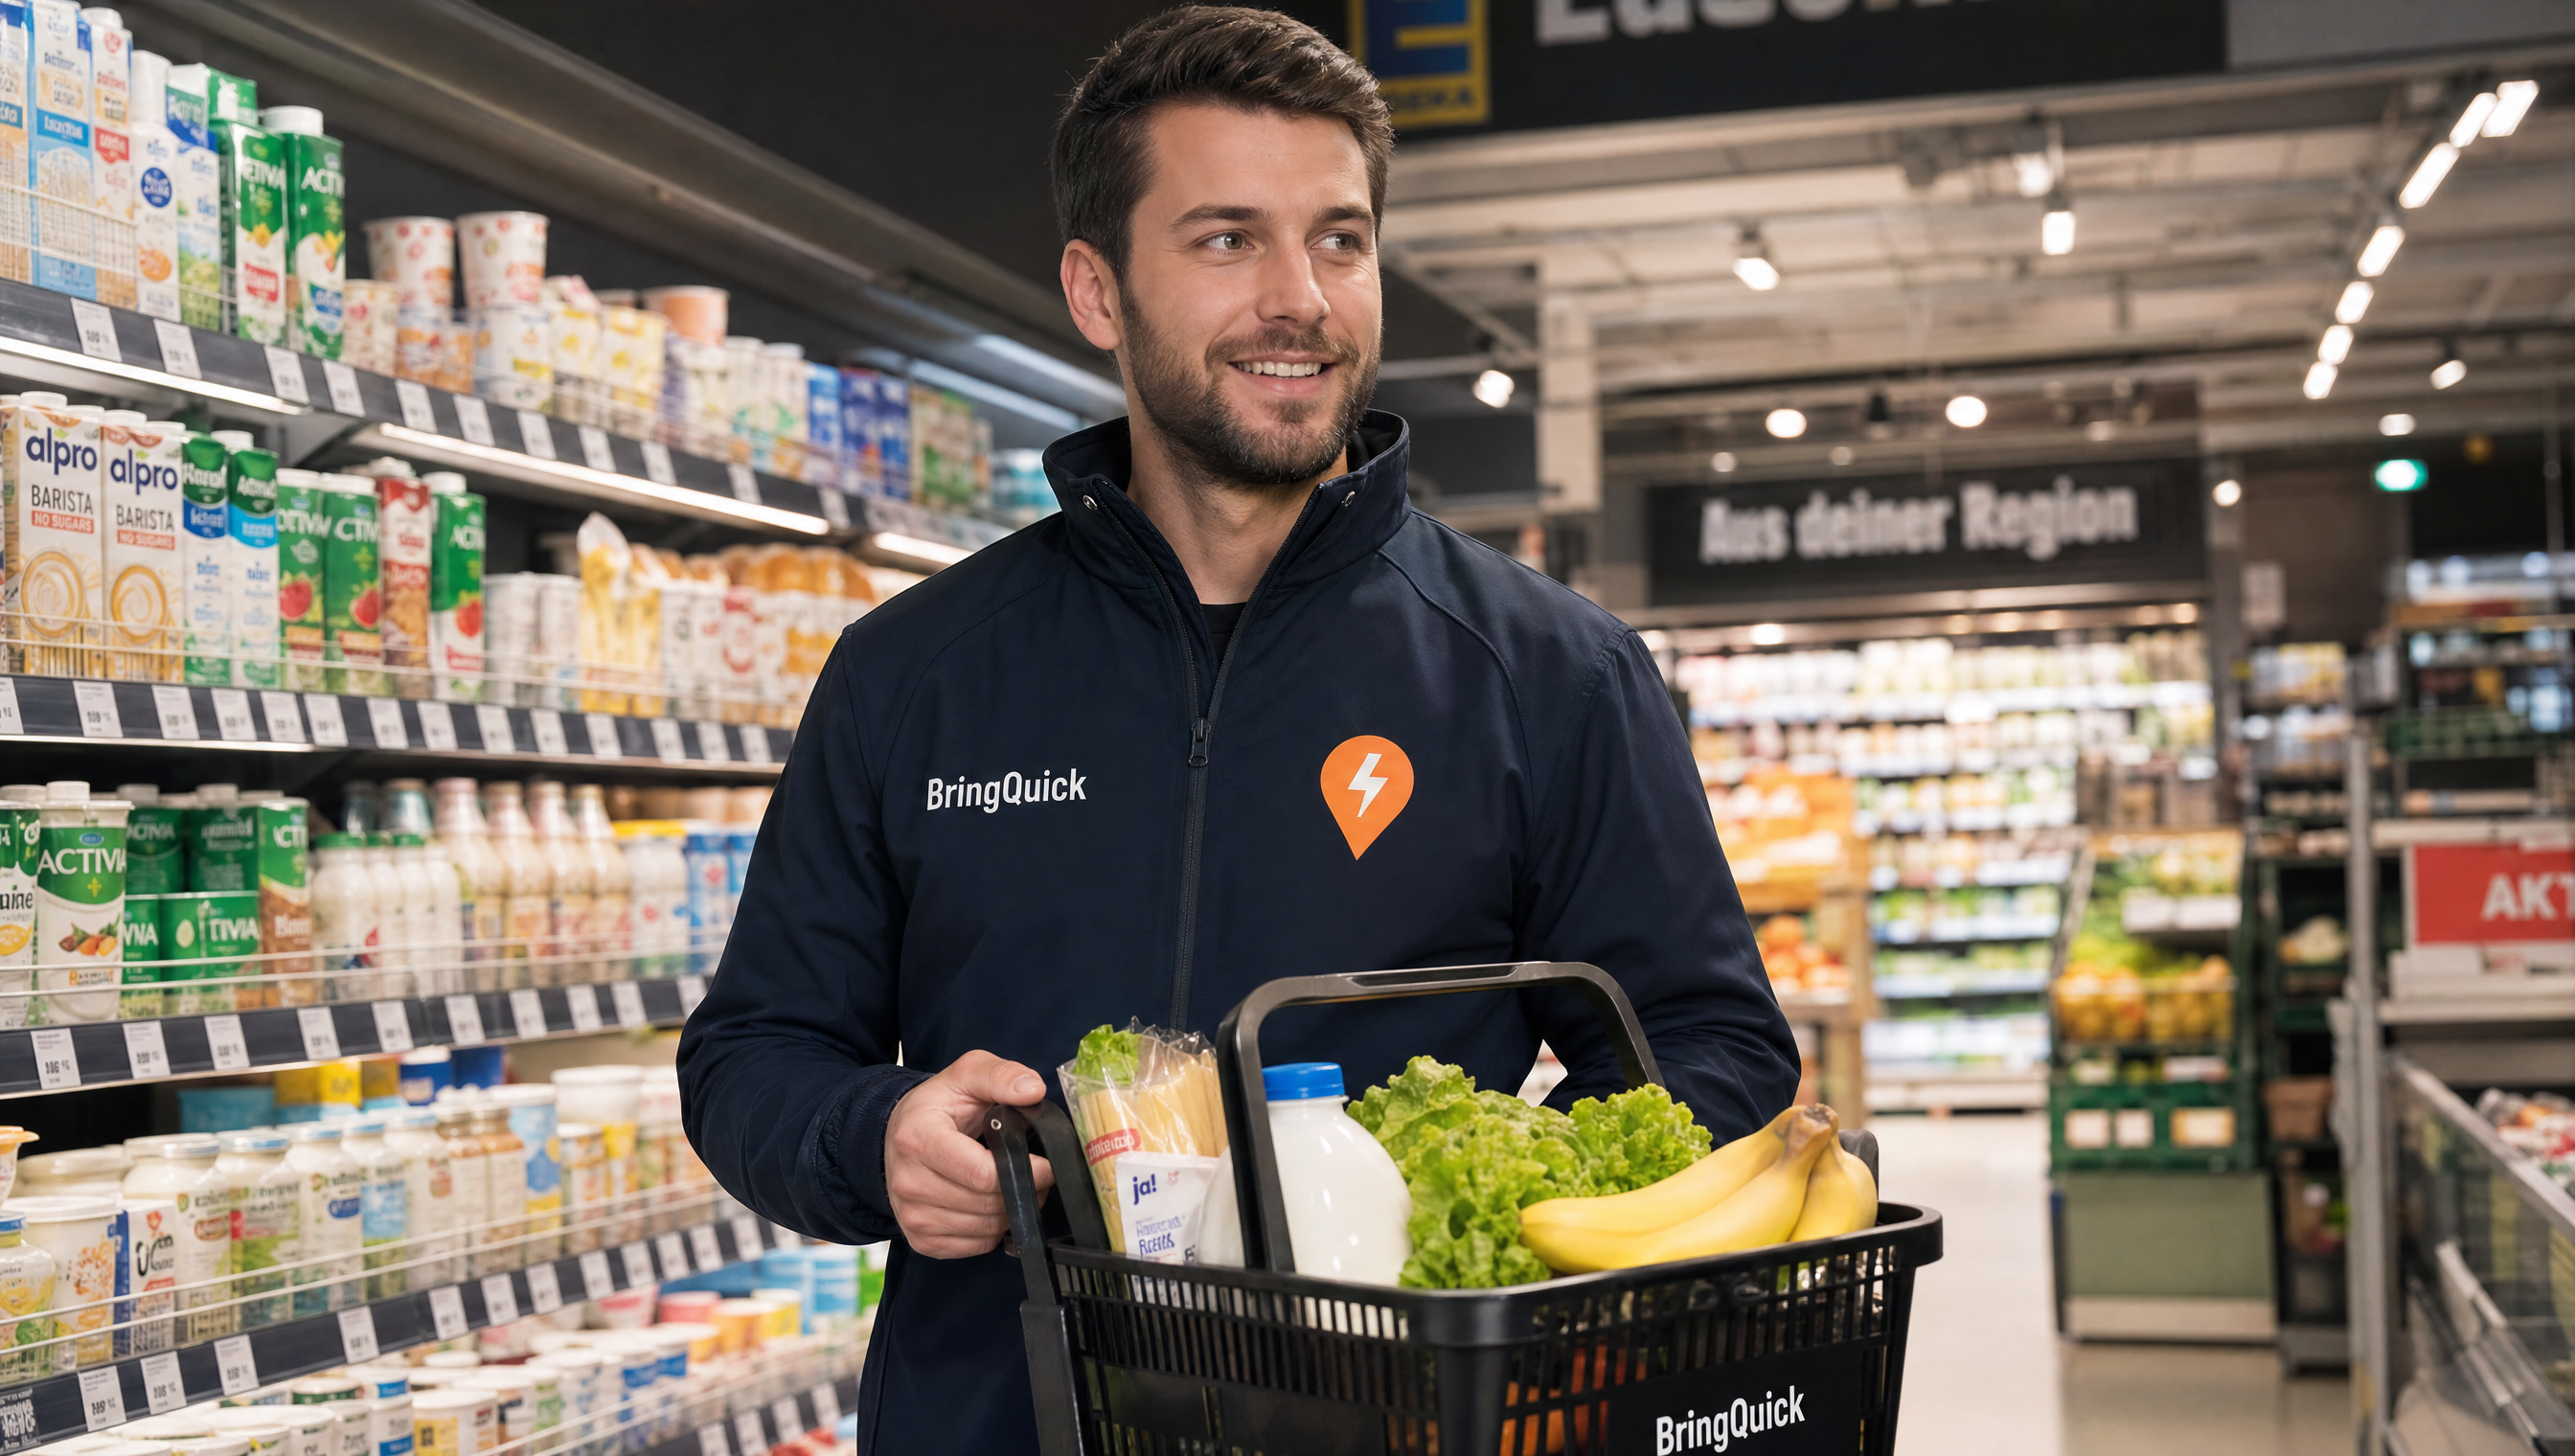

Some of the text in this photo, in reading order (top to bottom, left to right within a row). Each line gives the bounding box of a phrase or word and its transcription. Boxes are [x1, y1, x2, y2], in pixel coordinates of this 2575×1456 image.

[26, 427, 98, 475] alpro
[110, 449, 178, 495] alpro
[32, 485, 93, 515] BARISTA
[34, 512, 49, 527] NO
[117, 505, 174, 533] BARISTA
[1699, 475, 2138, 564] Aus deiner Region
[927, 768, 1087, 813] BringQuick
[1132, 1173, 1156, 1205] ja!
[1656, 1385, 1806, 1456] BringQuick
